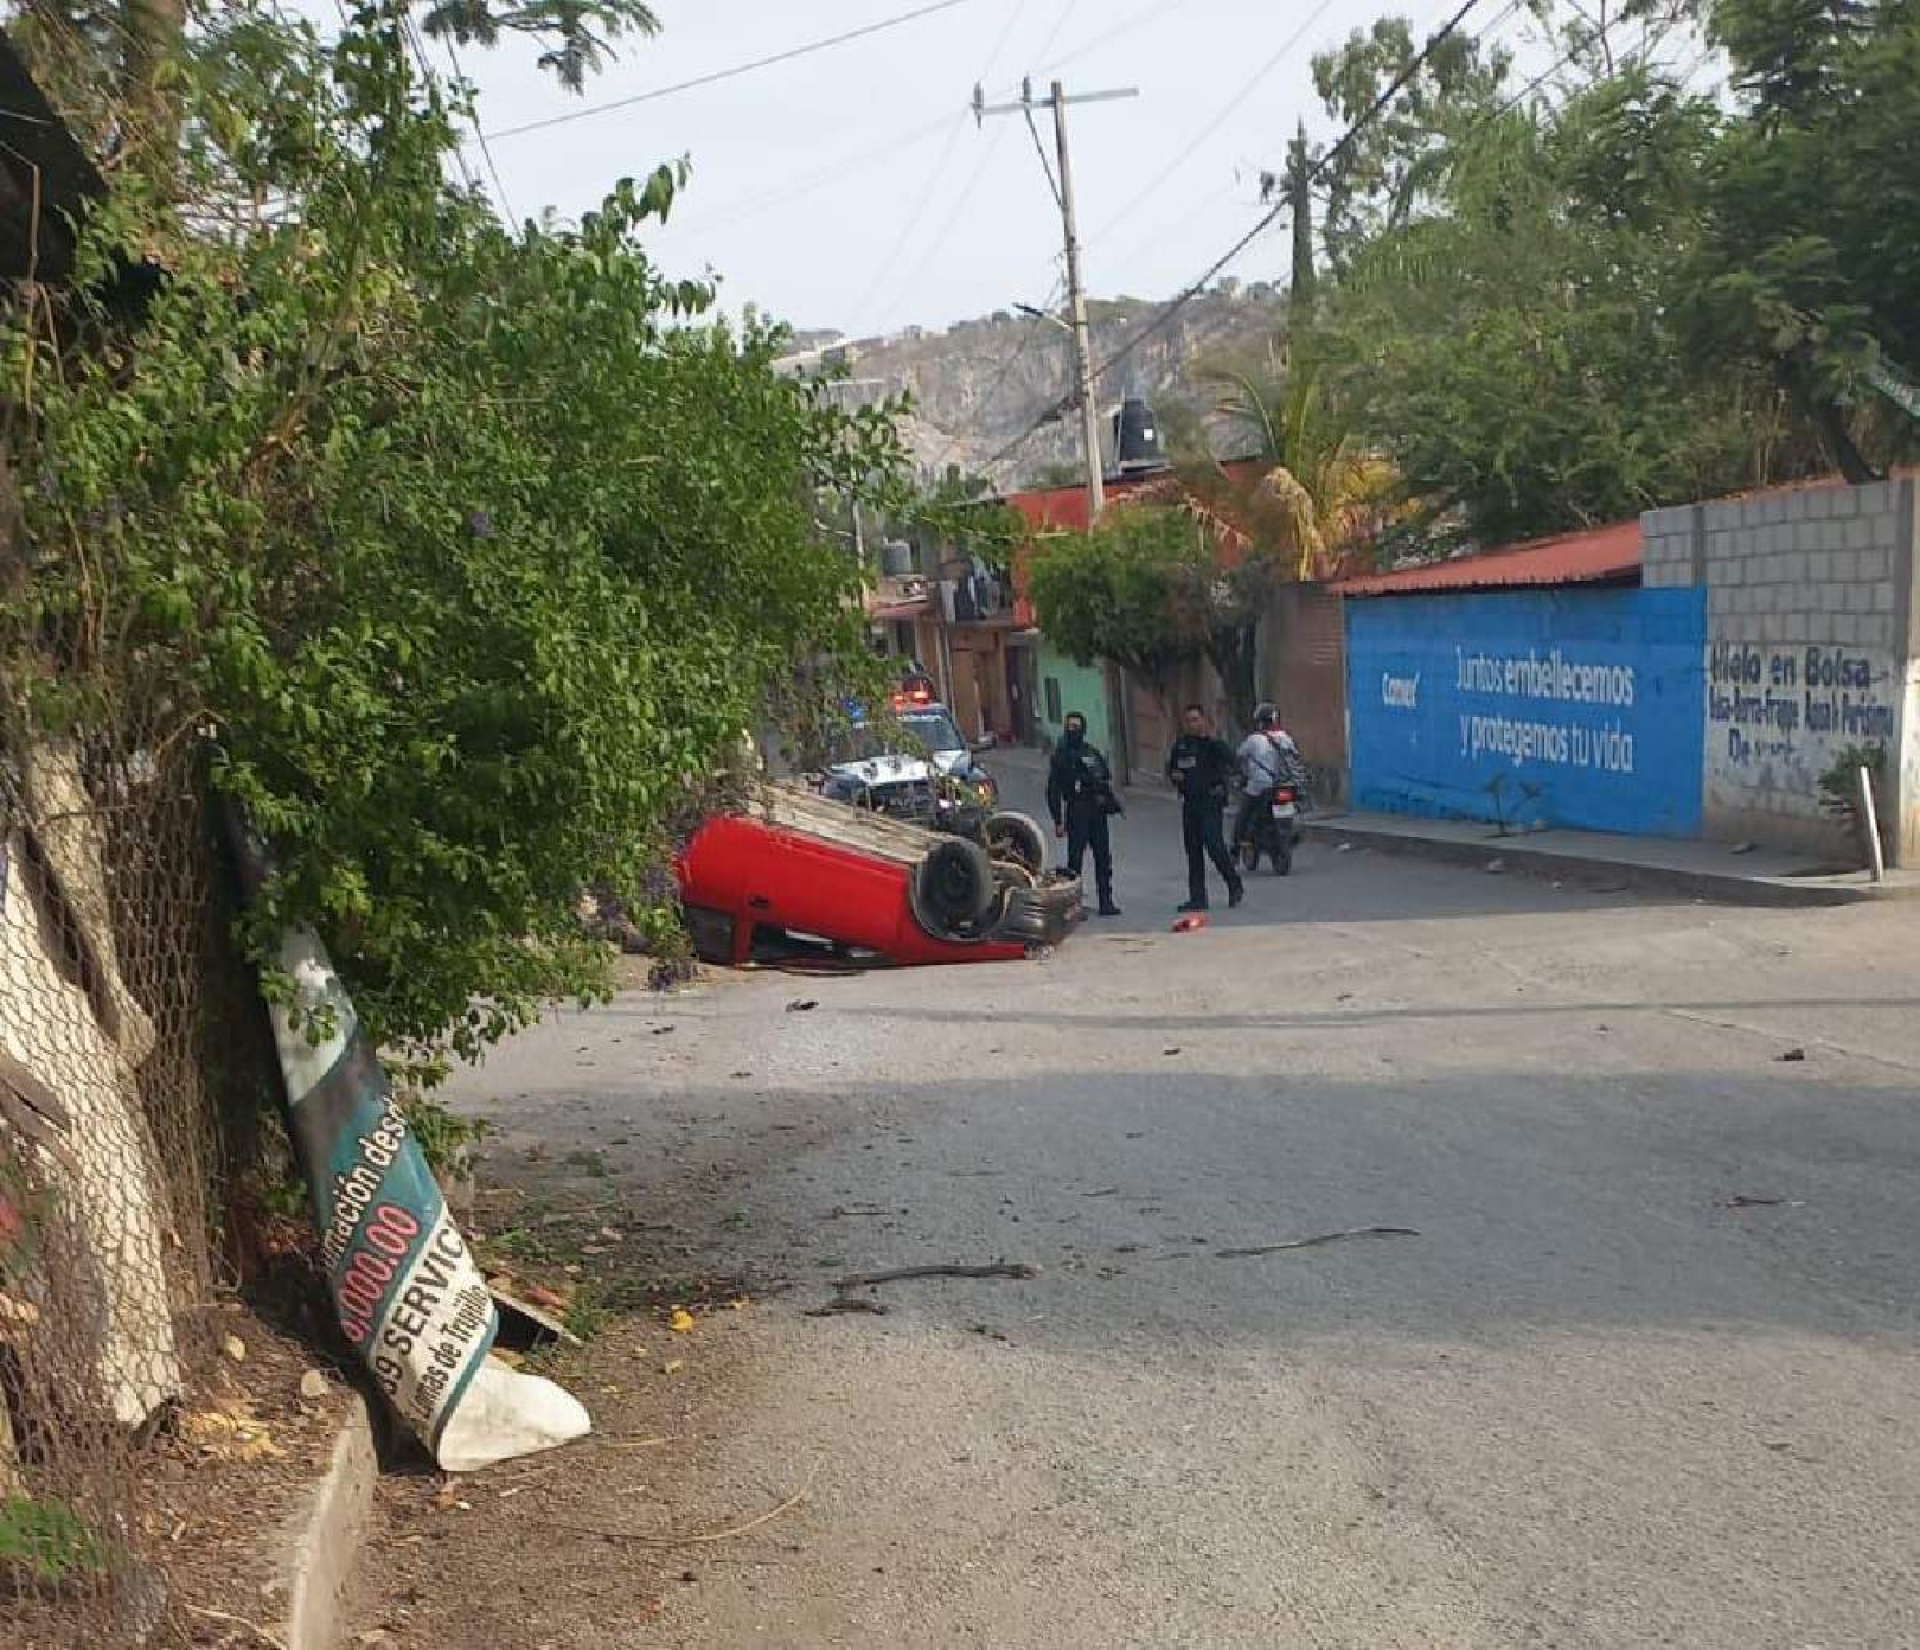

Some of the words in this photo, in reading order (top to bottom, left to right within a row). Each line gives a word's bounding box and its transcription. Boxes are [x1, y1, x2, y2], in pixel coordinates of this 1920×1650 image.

[1456, 645, 1501, 691] Juntos
[1505, 648, 1633, 705] embellecemos
[1771, 653, 1796, 686] en
[1805, 646, 1870, 689] Bolsa
[1459, 716, 1469, 757] y
[1471, 714, 1569, 767] protegemos
[1573, 722, 1589, 765] tu
[1593, 717, 1633, 772] vida
[428, 1342, 462, 1370] de
